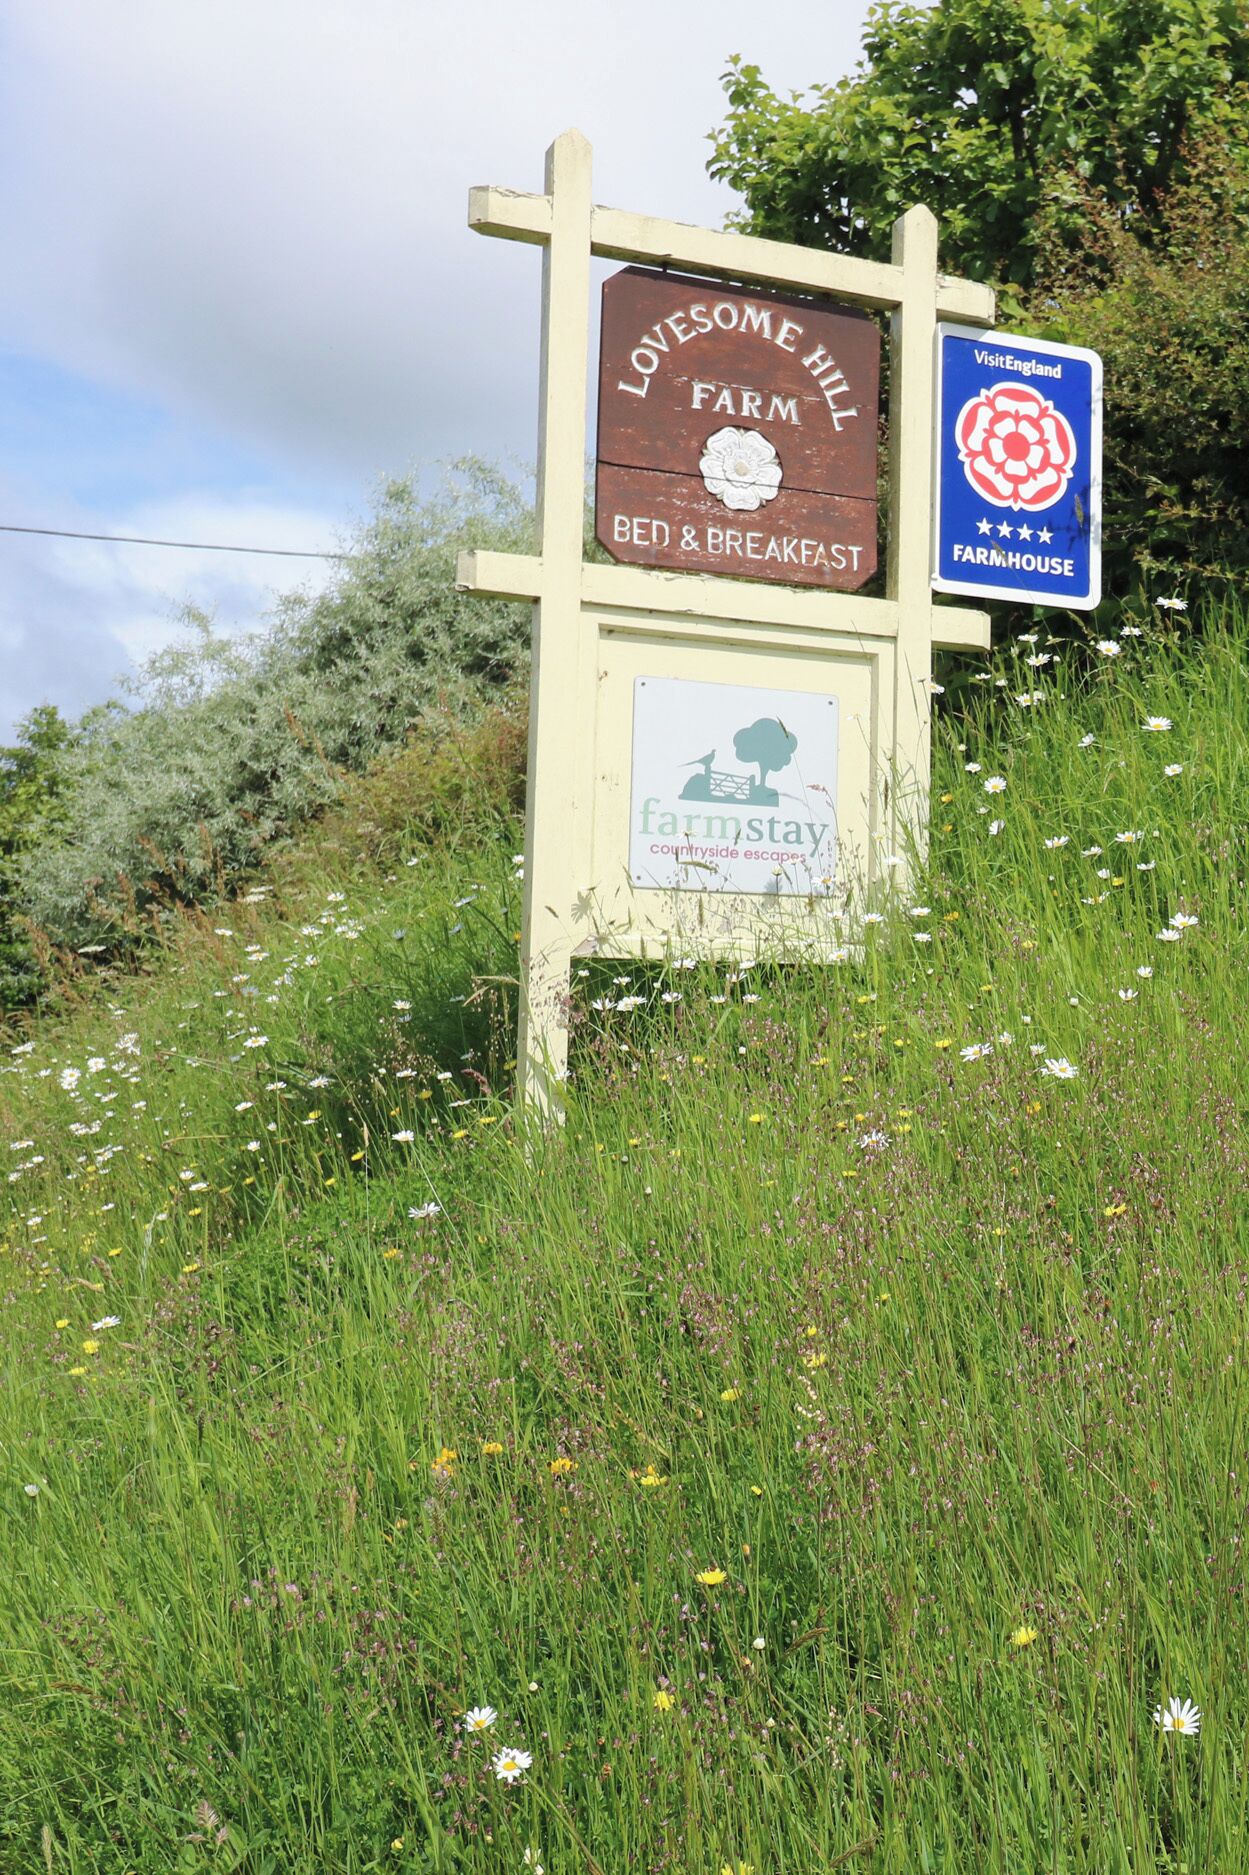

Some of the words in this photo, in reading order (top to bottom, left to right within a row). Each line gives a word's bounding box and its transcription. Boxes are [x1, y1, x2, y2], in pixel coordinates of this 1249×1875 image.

[618, 301, 804, 399] LOVESOME
[801, 343, 858, 432] HILL
[974, 349, 1062, 379] VisitEngland
[690, 381, 801, 425] FARM
[613, 514, 670, 548] BED
[679, 524, 700, 551] &
[706, 527, 863, 572] BREAKFAST
[953, 544, 1075, 577] FARMHOUSE
[638, 796, 830, 858] farmstay
[650, 842, 740, 860] countryside
[744, 848, 807, 865] escapes
